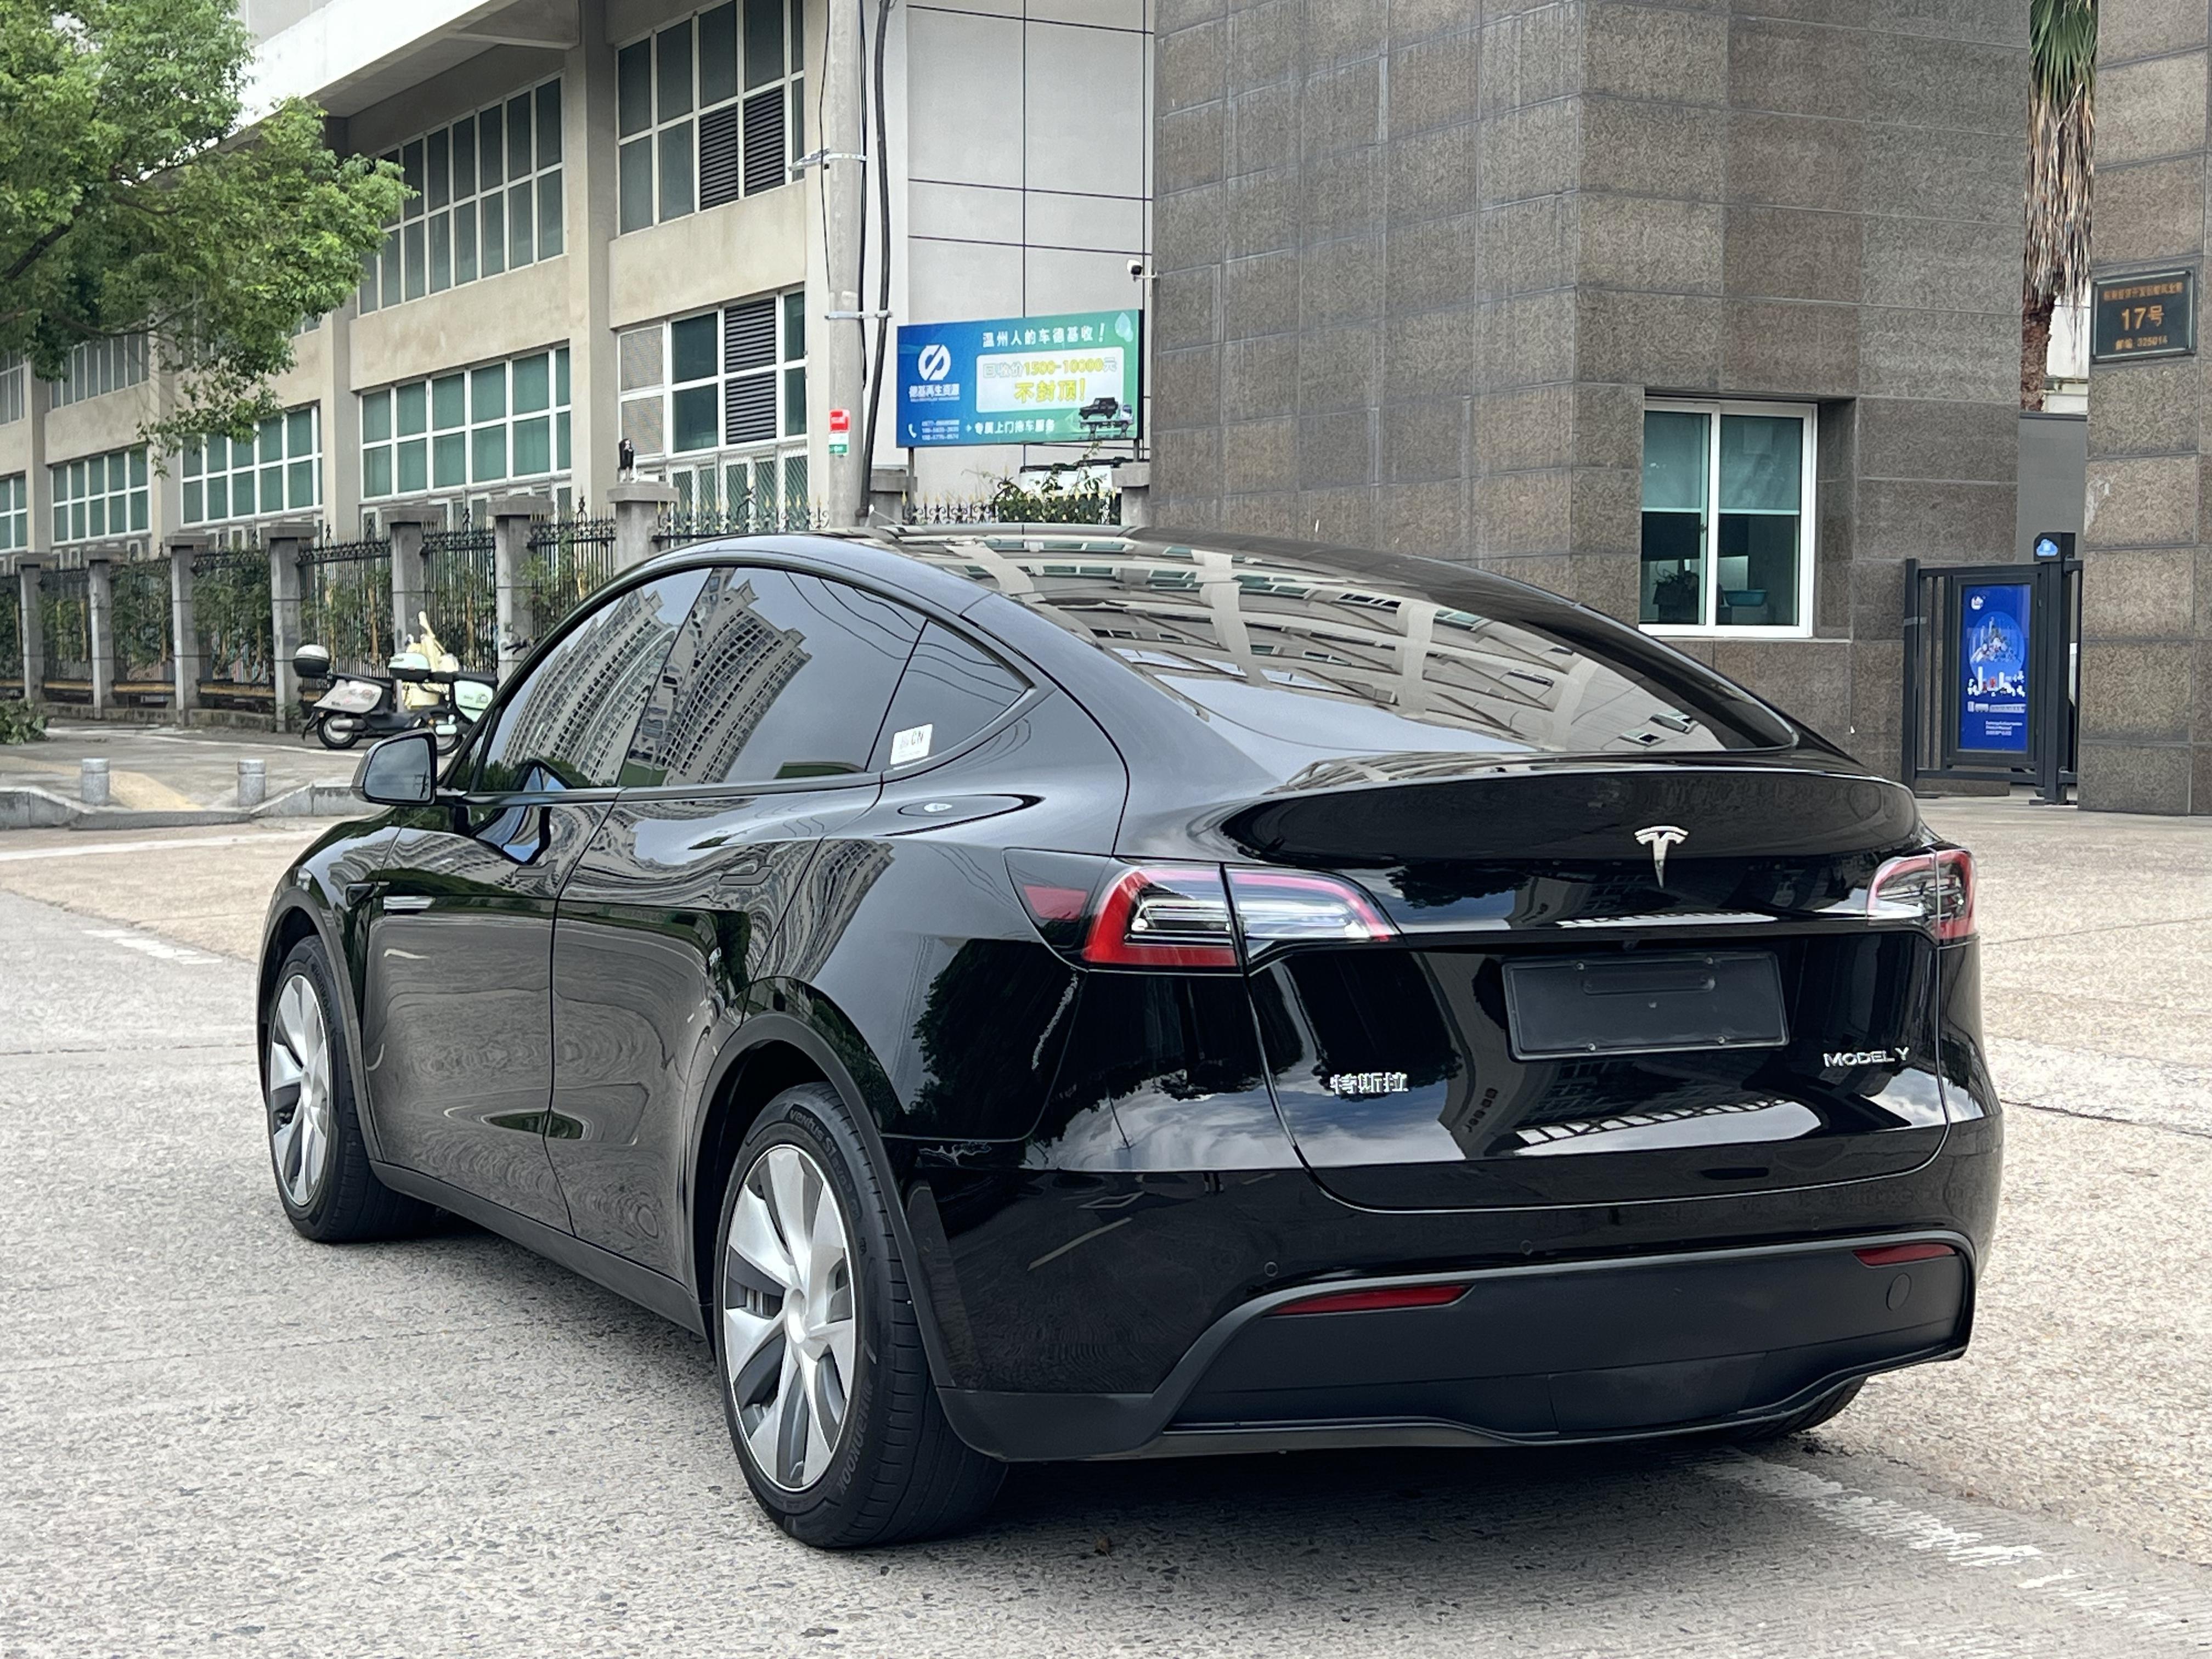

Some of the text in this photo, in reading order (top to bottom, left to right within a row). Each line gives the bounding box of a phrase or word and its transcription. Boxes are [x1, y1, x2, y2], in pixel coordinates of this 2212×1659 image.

[2121, 304, 2164, 330] 17号
[1823, 1047, 1909, 1067] MODEL Y
[1330, 1072, 1409, 1095] 特斯拉
